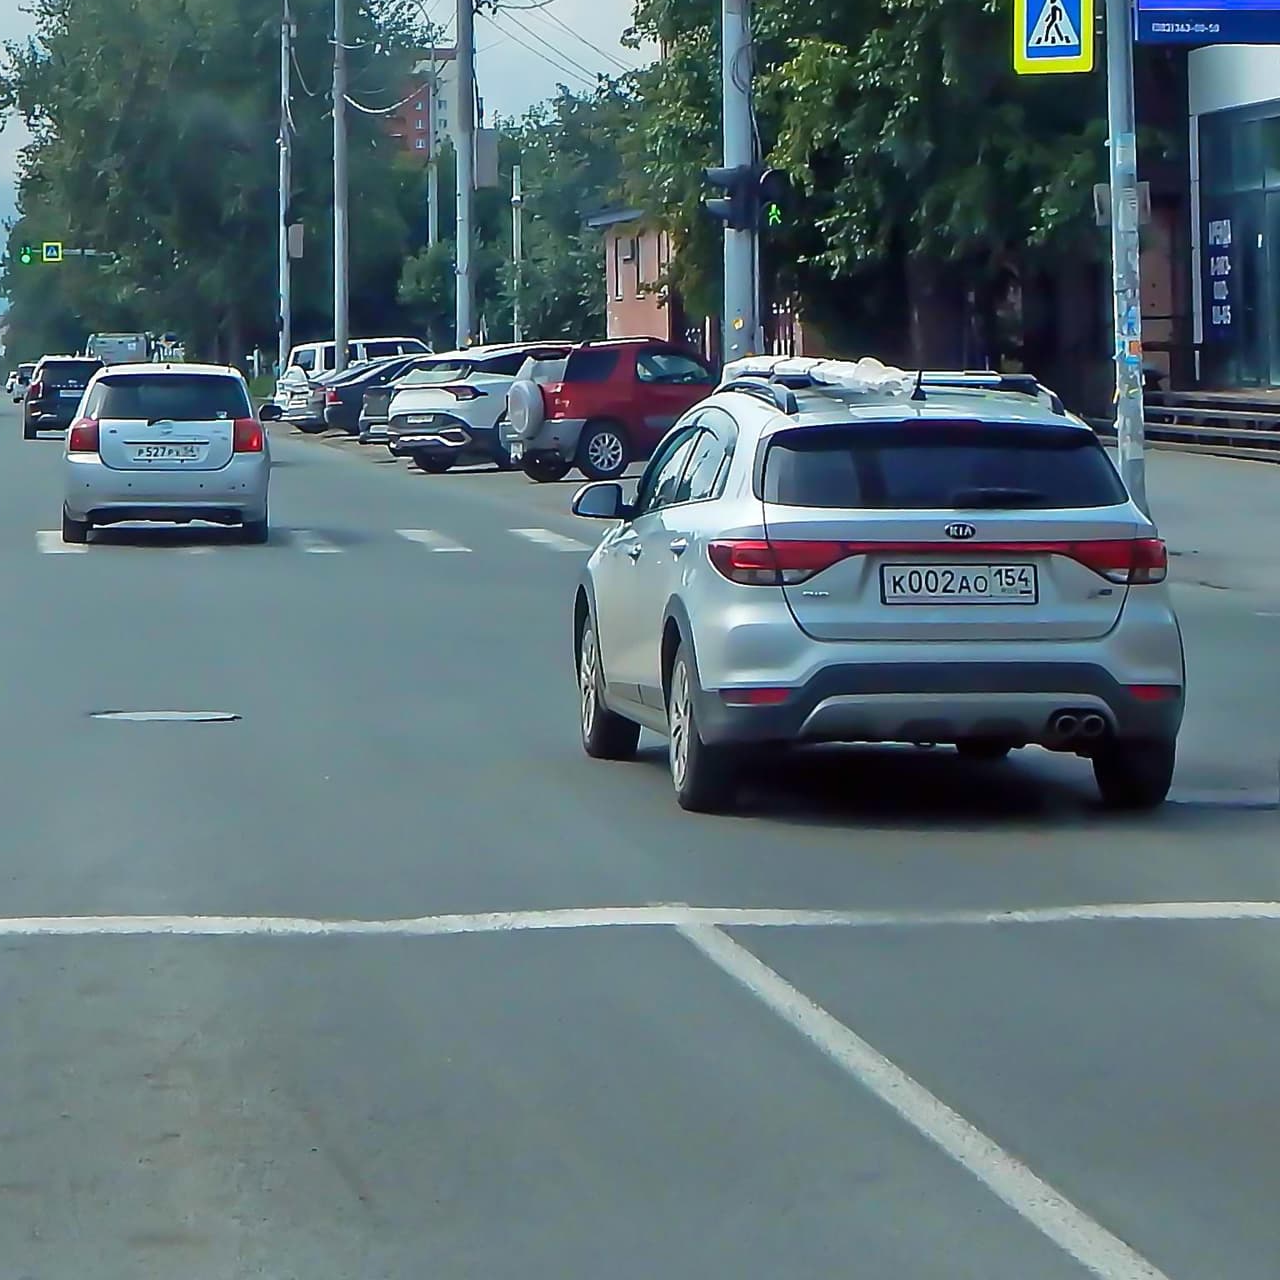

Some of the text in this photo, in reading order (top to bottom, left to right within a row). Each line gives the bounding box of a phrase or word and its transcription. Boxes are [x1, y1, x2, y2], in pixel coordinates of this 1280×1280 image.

[949, 525, 972, 536] KIA
[892, 567, 1029, 594] К002АО 154
